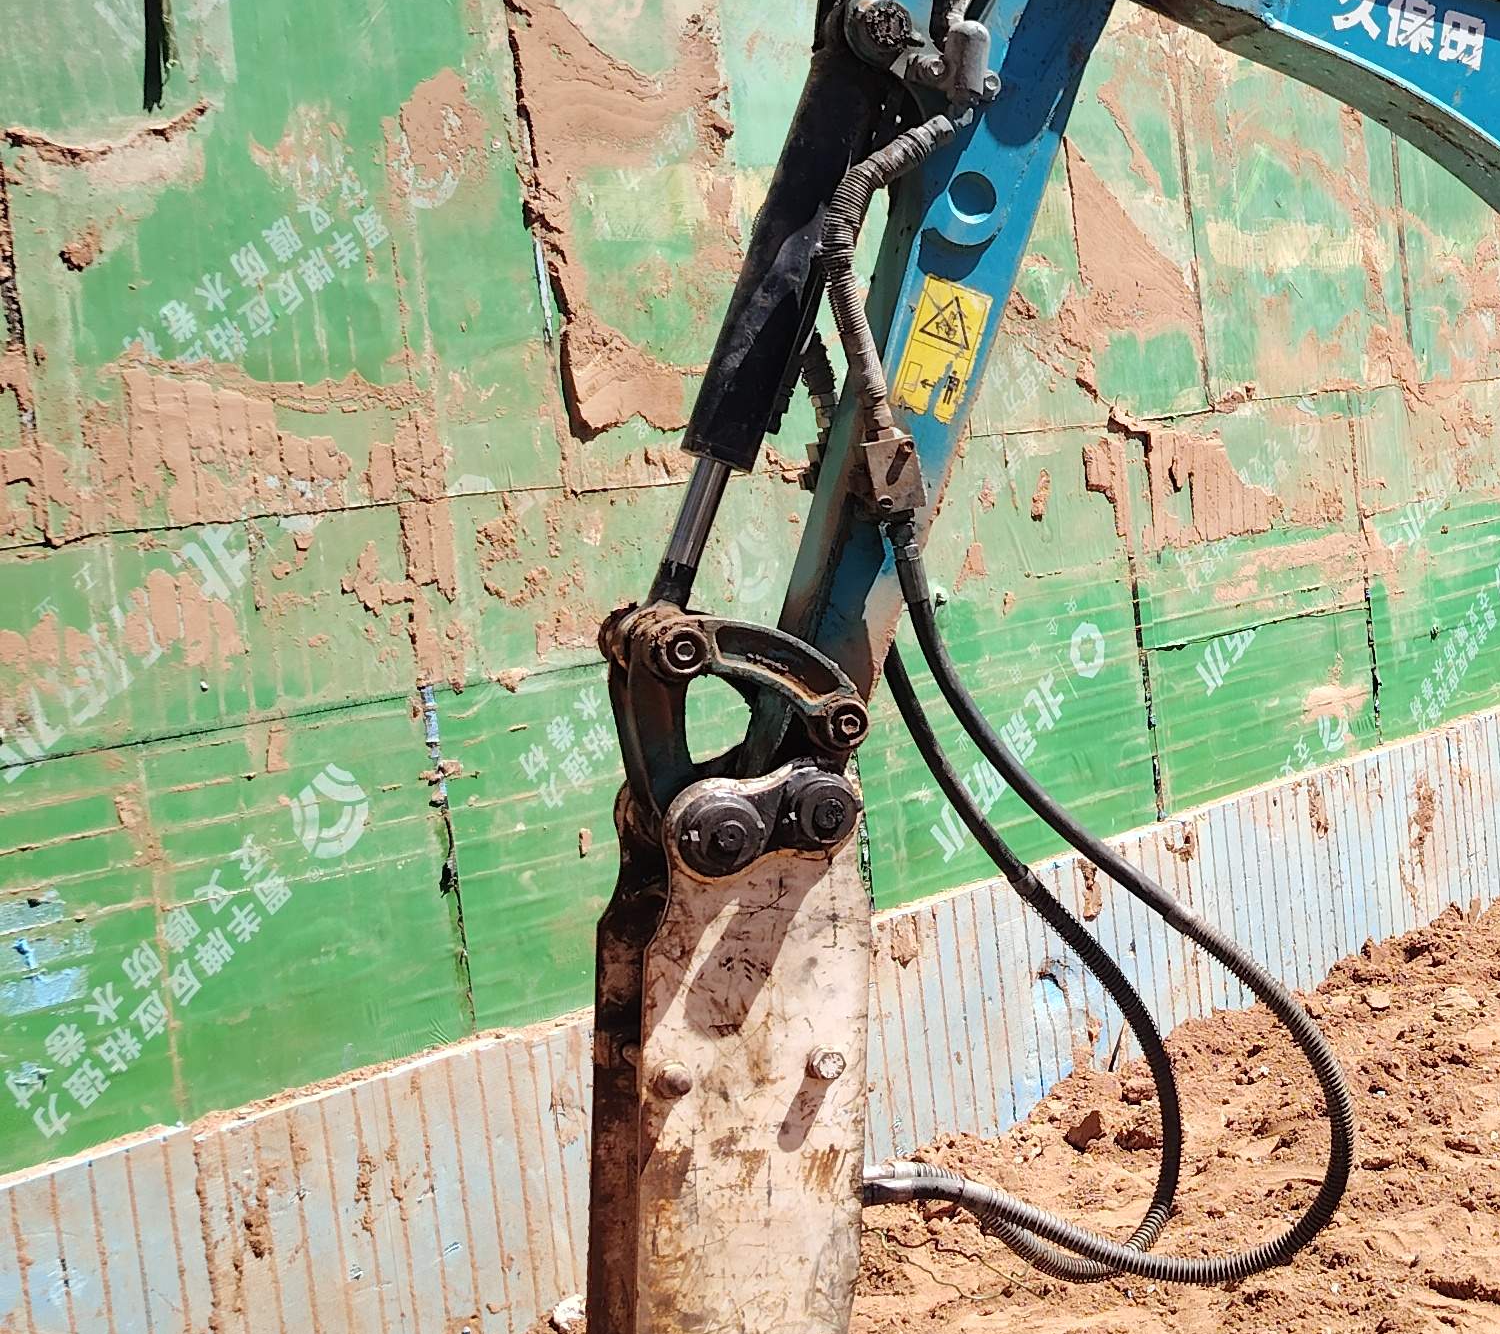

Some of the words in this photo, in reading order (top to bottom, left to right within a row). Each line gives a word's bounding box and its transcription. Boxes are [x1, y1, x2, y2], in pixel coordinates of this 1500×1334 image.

[536, 712, 616, 814] 粘强力
[37, 866, 292, 1143] 蜀羊牌反应粘强力
